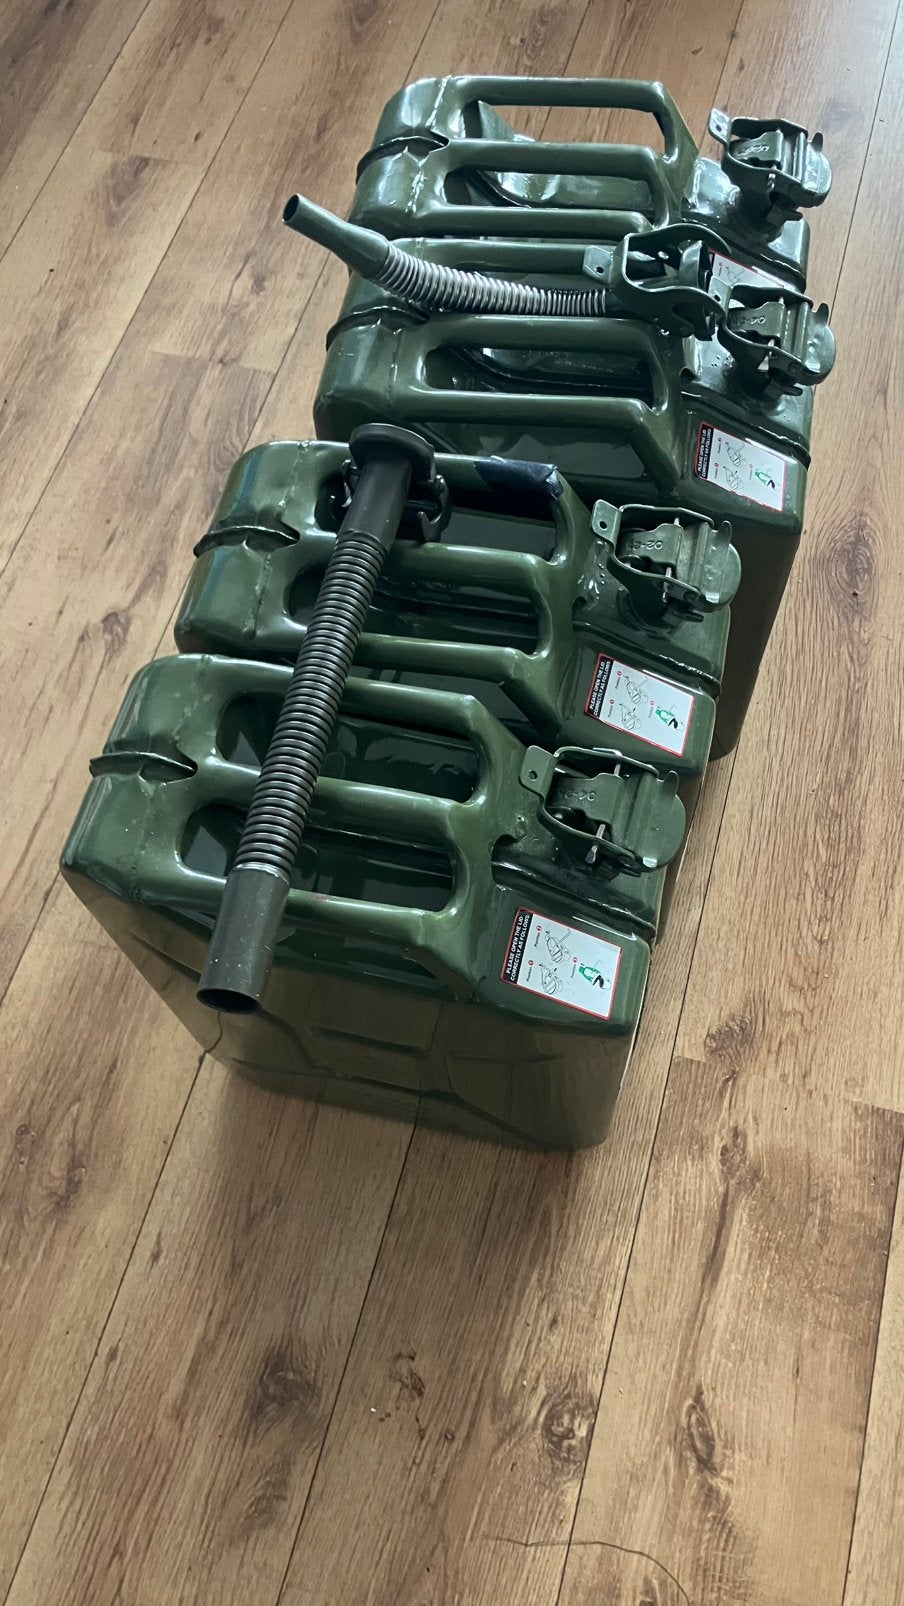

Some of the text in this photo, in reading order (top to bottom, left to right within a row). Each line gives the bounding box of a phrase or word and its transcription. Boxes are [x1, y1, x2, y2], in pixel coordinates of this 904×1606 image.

[589, 692, 597, 709] PLEASE
[593, 679, 601, 692] OPEN
[594, 689, 603, 716] CORRECTLY
[506, 953, 514, 974] PLEASE
[514, 926, 522, 937] THE
[510, 949, 521, 981] CORRECTLY
[517, 940, 524, 949] AS
